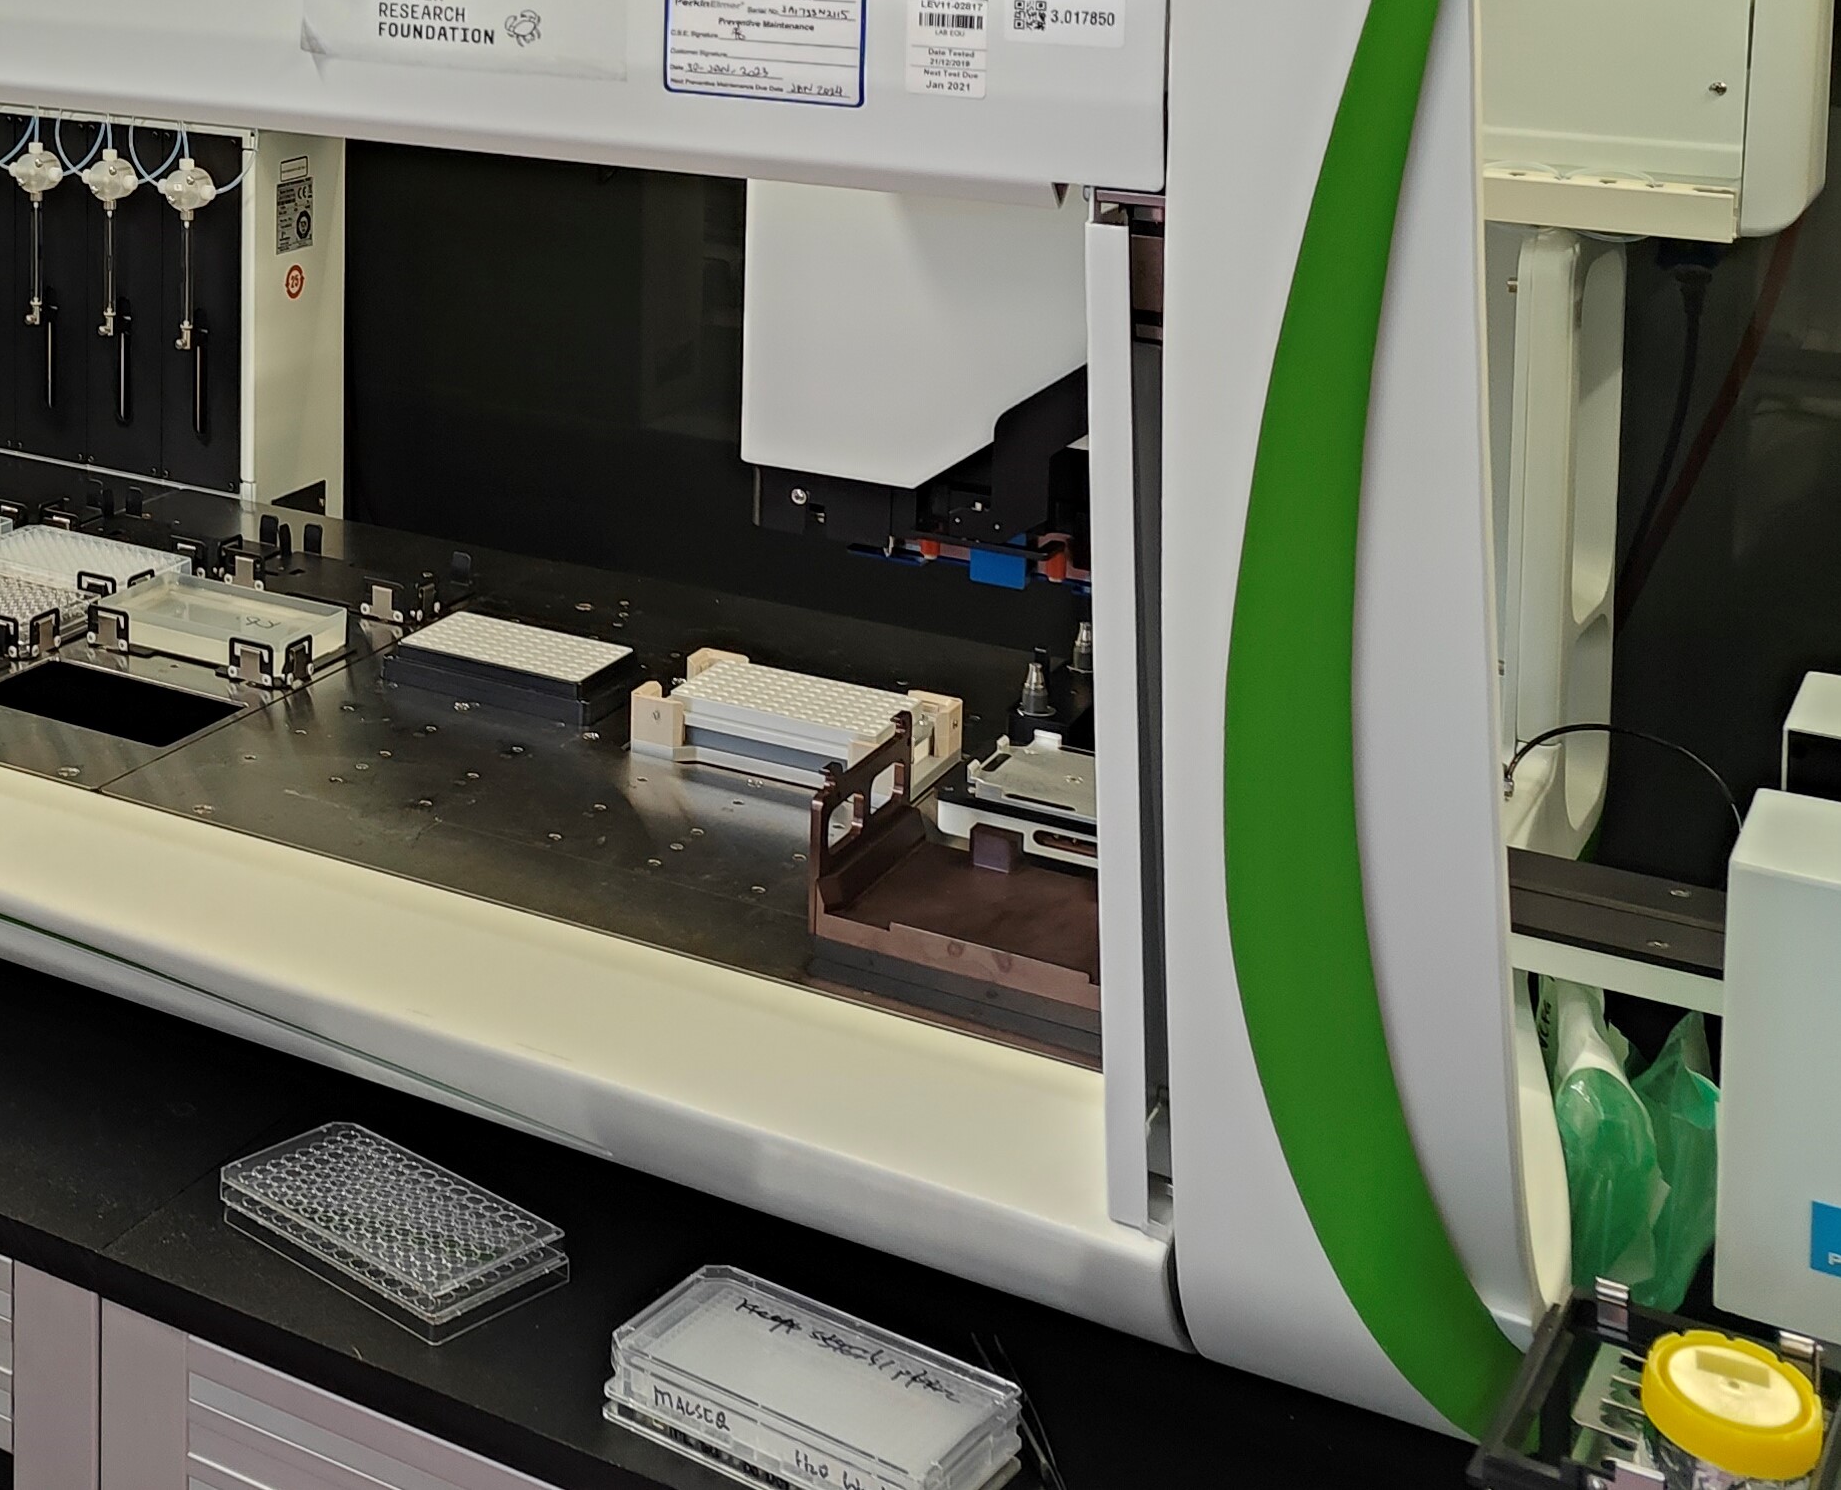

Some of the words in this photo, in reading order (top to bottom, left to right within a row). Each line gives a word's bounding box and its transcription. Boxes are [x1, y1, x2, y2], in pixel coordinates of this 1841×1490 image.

[378, 2, 466, 23] RESEARCH
[1050, 9, 1116, 27] 3.017850
[718, 17, 761, 30] Preventive
[762, 20, 815, 32] Maintenance
[378, 21, 496, 45] FOUNDATION
[928, 47, 946, 56] Date
[948, 48, 975, 58] Tested
[924, 68, 941, 77] Next
[943, 69, 960, 78] Test
[962, 70, 979, 79] Due
[925, 80, 944, 90] Jan
[947, 81, 971, 92] 2021
